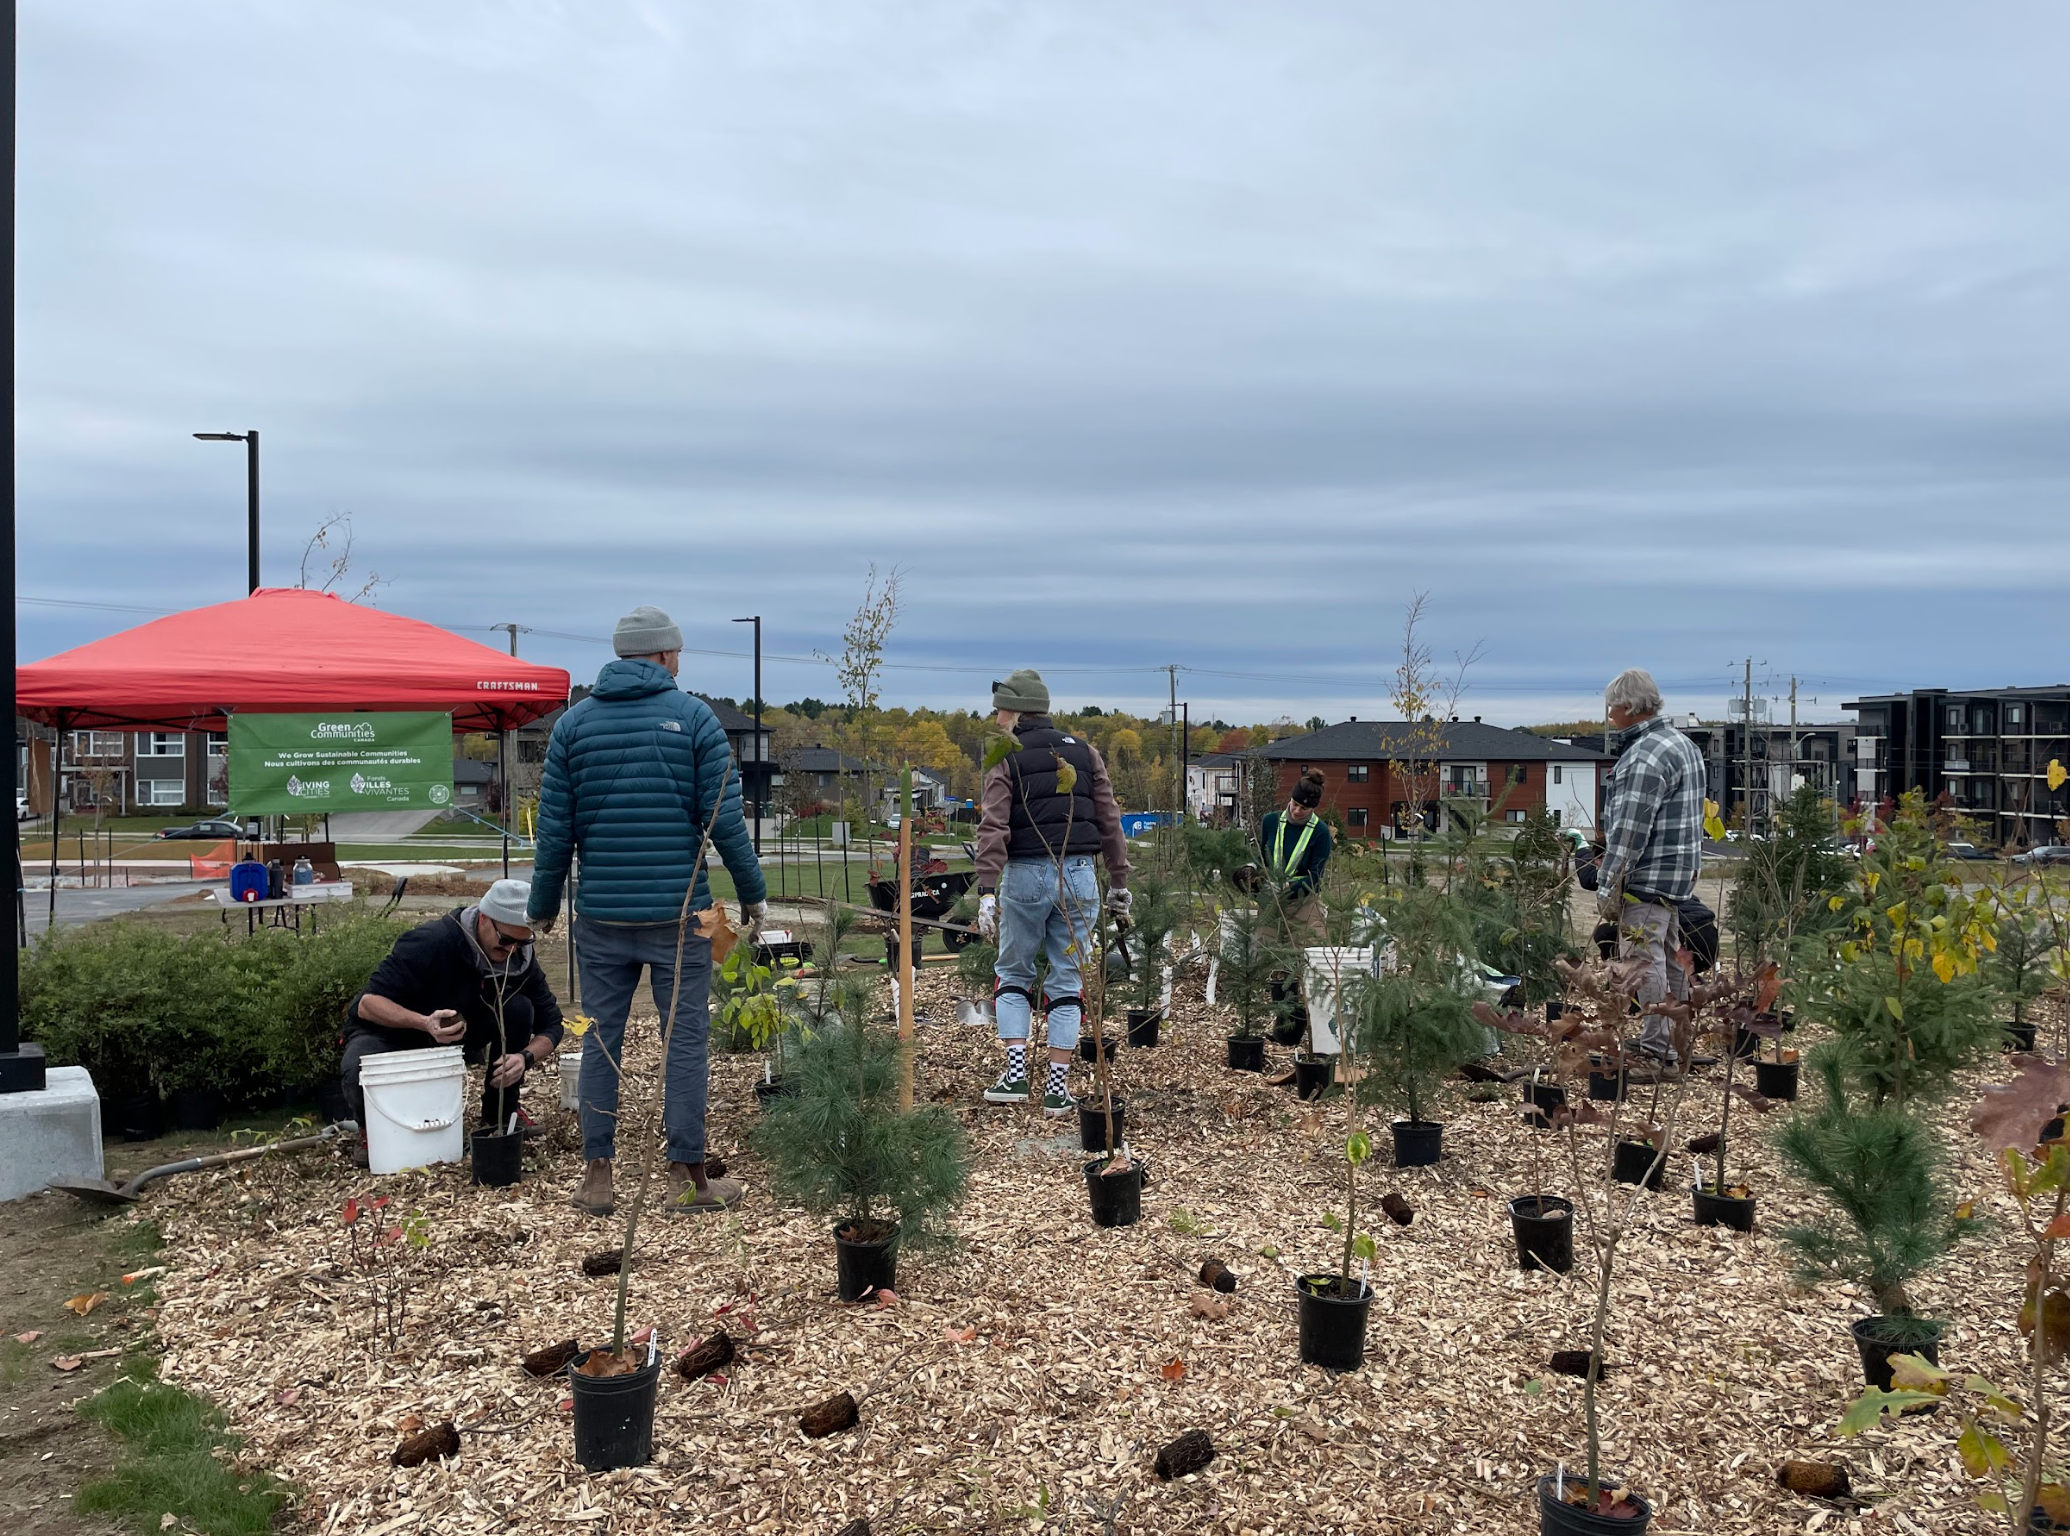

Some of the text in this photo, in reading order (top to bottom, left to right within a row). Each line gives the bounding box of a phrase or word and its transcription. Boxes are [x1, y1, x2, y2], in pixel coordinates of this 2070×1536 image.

[477, 681, 538, 691] CRAFTSMAN
[317, 722, 351, 732] Green
[310, 729, 375, 739] Communities
[364, 787, 410, 796] VIVANTES
